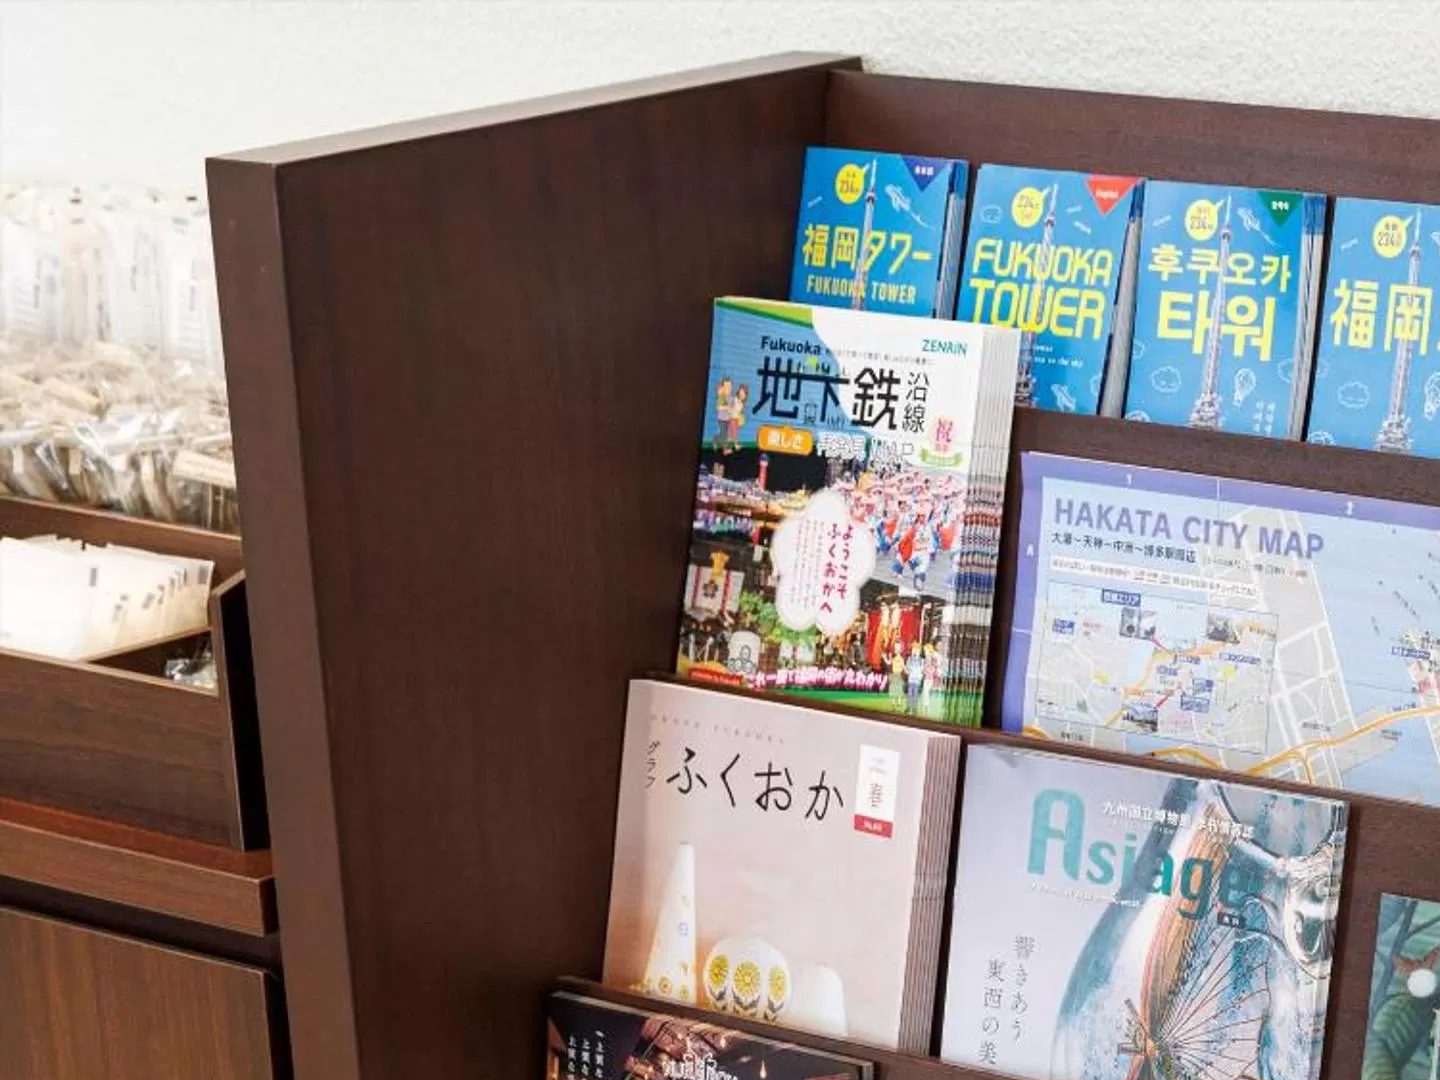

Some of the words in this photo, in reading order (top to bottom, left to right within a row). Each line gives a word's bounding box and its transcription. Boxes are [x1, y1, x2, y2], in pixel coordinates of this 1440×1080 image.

[802, 222, 935, 275] 福岡タワー
[972, 237, 1115, 288] FUKUOKA
[1147, 243, 1293, 292] 후쿠오카
[806, 274, 867, 297] FUKUOKA
[871, 280, 917, 305] TOWER
[967, 278, 1107, 340] TOWER
[760, 335, 822, 357] Fukuoka
[921, 338, 968, 357] ZENRIN
[1156, 289, 1277, 362] 타워
[752, 355, 902, 431] 地下鉄
[901, 370, 931, 434] 沿線
[1055, 497, 1172, 540] HAKATA
[1182, 515, 1249, 551] CITY
[1258, 526, 1325, 561] MAP
[819, 522, 842, 614] ふくおかへ
[665, 746, 845, 821] ふくおか
[1026, 788, 1250, 921] Asiage
